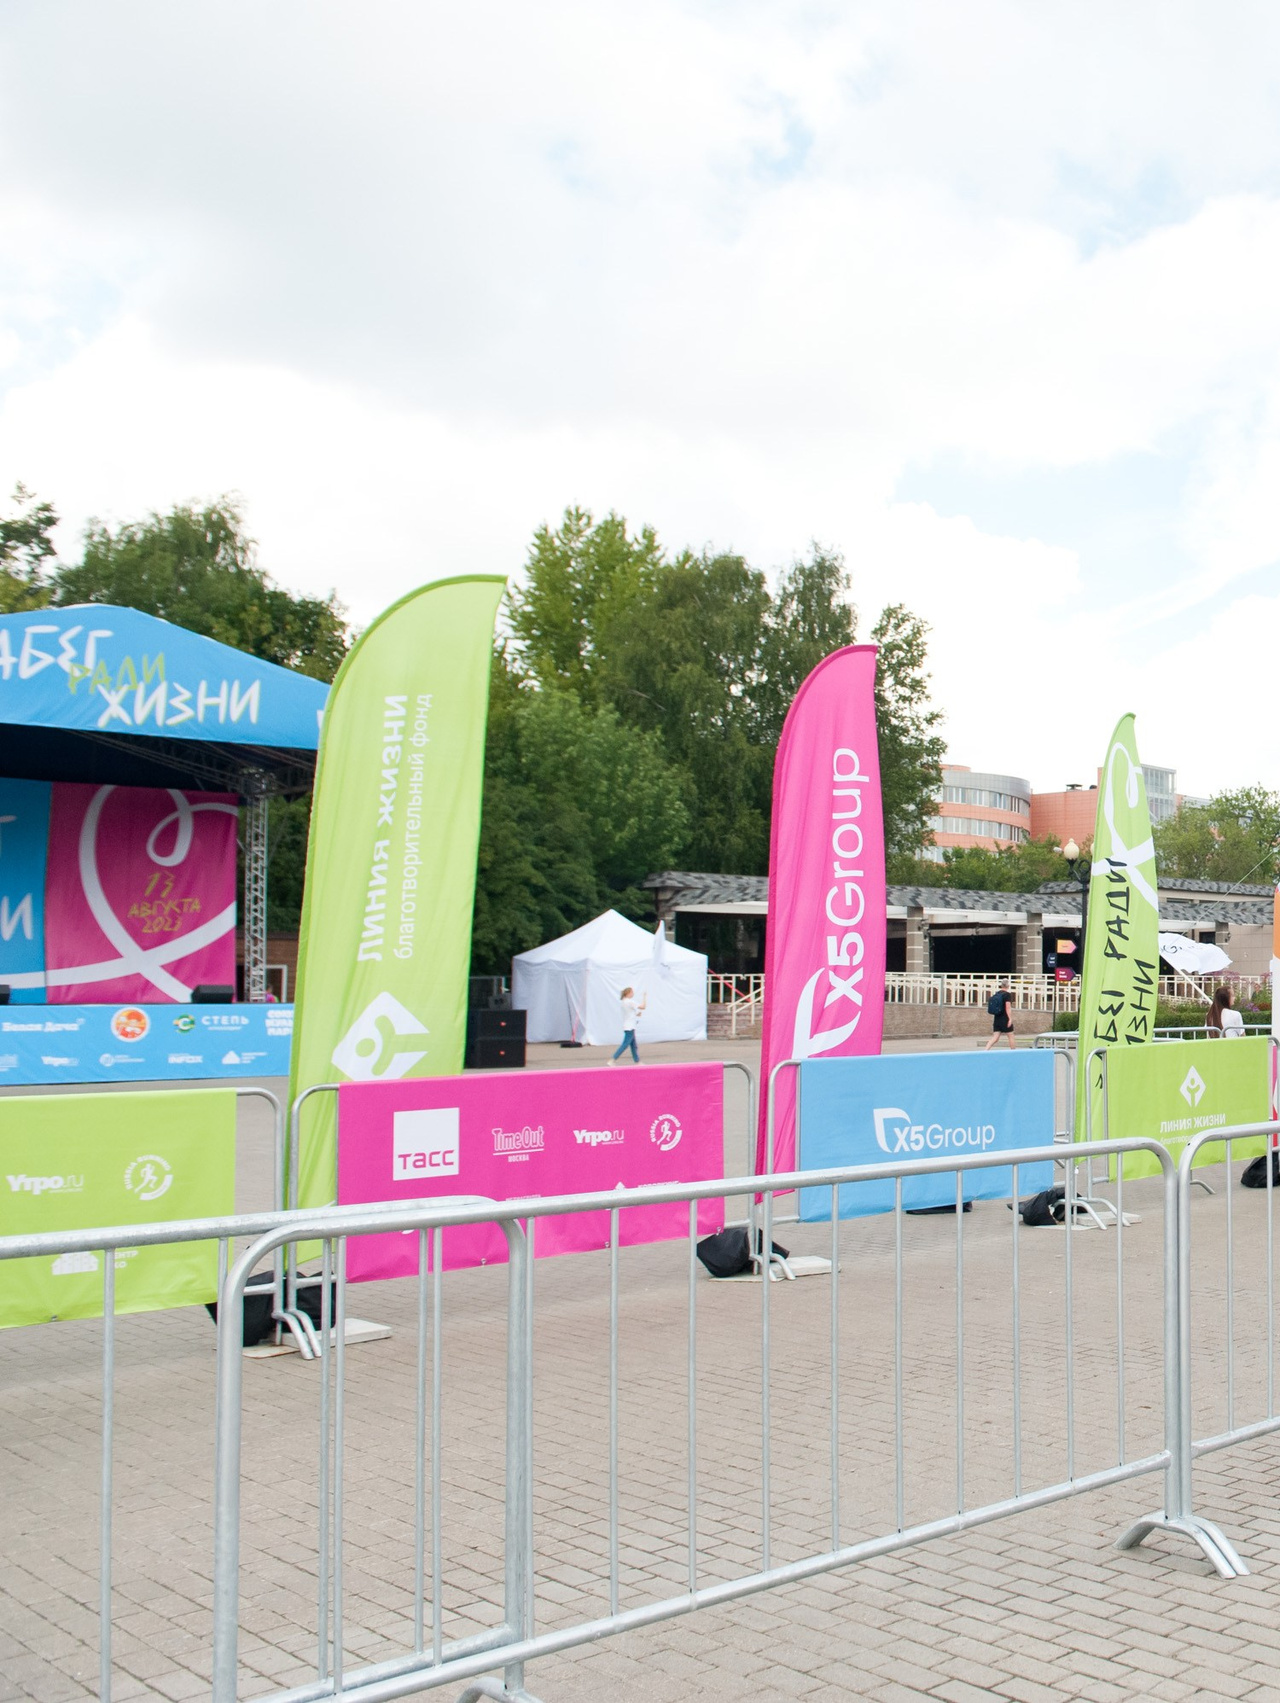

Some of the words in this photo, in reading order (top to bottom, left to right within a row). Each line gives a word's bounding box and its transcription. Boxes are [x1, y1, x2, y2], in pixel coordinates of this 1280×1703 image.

[97, 679, 260, 728] ЖИЗНИ
[357, 838, 389, 963] ЛИНИЯ
[377, 694, 408, 827] ЖИЗНИ
[393, 751, 426, 960] благотворительный
[411, 692, 433, 746] фонд
[202, 1016, 249, 1025] СТЕПЬ
[1160, 1118, 1192, 1133] ЛИНИЯ
[1194, 1113, 1226, 1128] ЖИЗНИ
